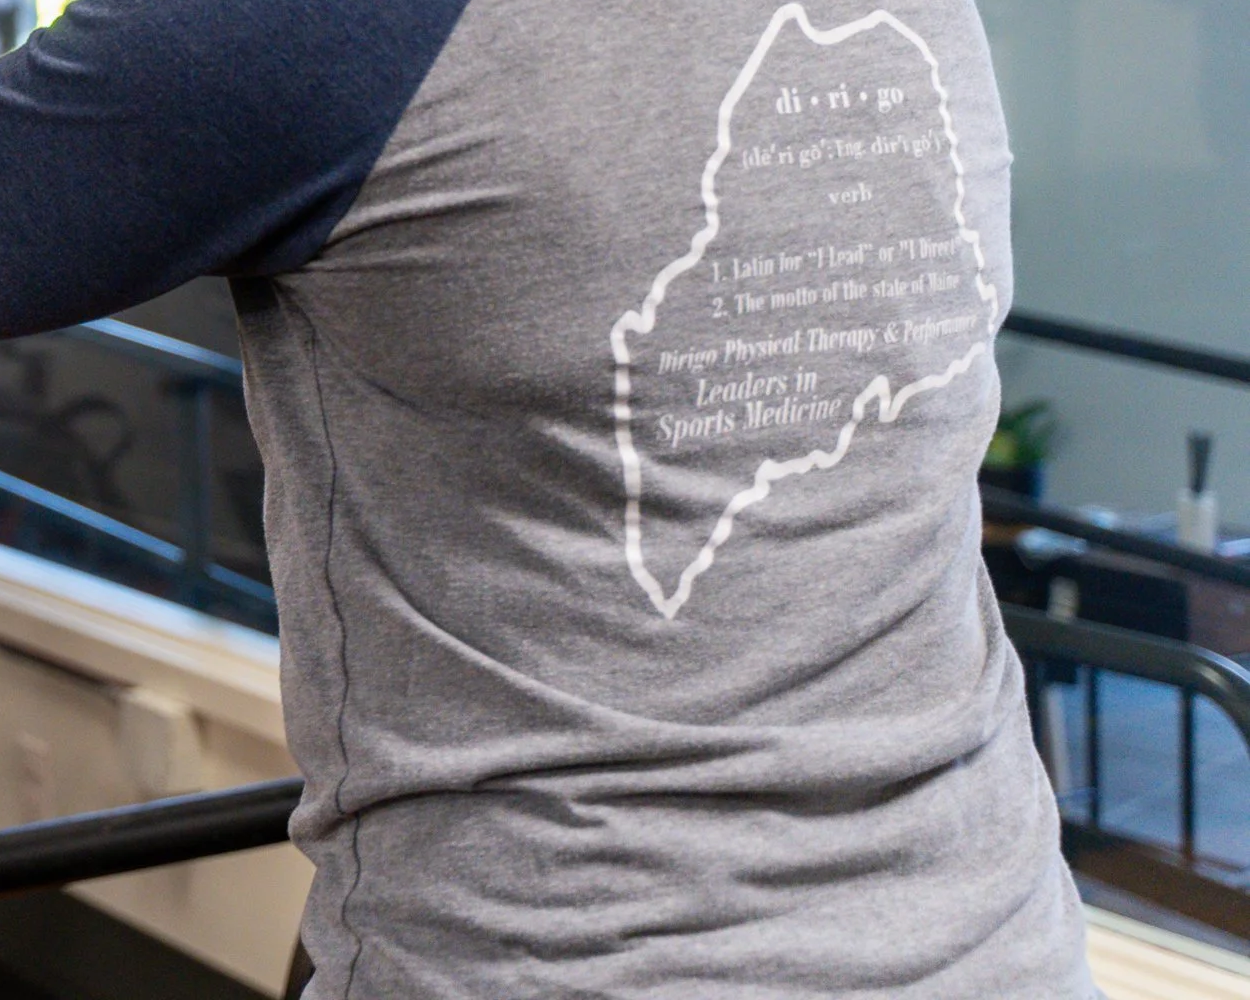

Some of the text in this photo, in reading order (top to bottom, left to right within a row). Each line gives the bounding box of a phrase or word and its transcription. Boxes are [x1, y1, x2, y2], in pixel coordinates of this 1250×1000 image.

[776, 87, 802, 114] di
[827, 82, 851, 109] ri
[877, 87, 904, 113] go
[828, 182, 872, 205] verb
[713, 262, 729, 283] 1.
[733, 255, 774, 279] Latin
[779, 251, 803, 273] for
[878, 246, 894, 262] or
[712, 297, 729, 318] 2.
[734, 292, 766, 314] The
[770, 287, 818, 309] motto
[822, 281, 838, 302] of
[843, 279, 868, 300] the
[872, 278, 907, 298] state
[911, 273, 925, 294] of
[658, 346, 718, 375] Dirigo
[723, 330, 800, 365] Physical
[806, 327, 876, 353] Therapy
[883, 321, 900, 344] &
[696, 366, 818, 407] Leaders in
[656, 395, 842, 448] Sports Medicine
